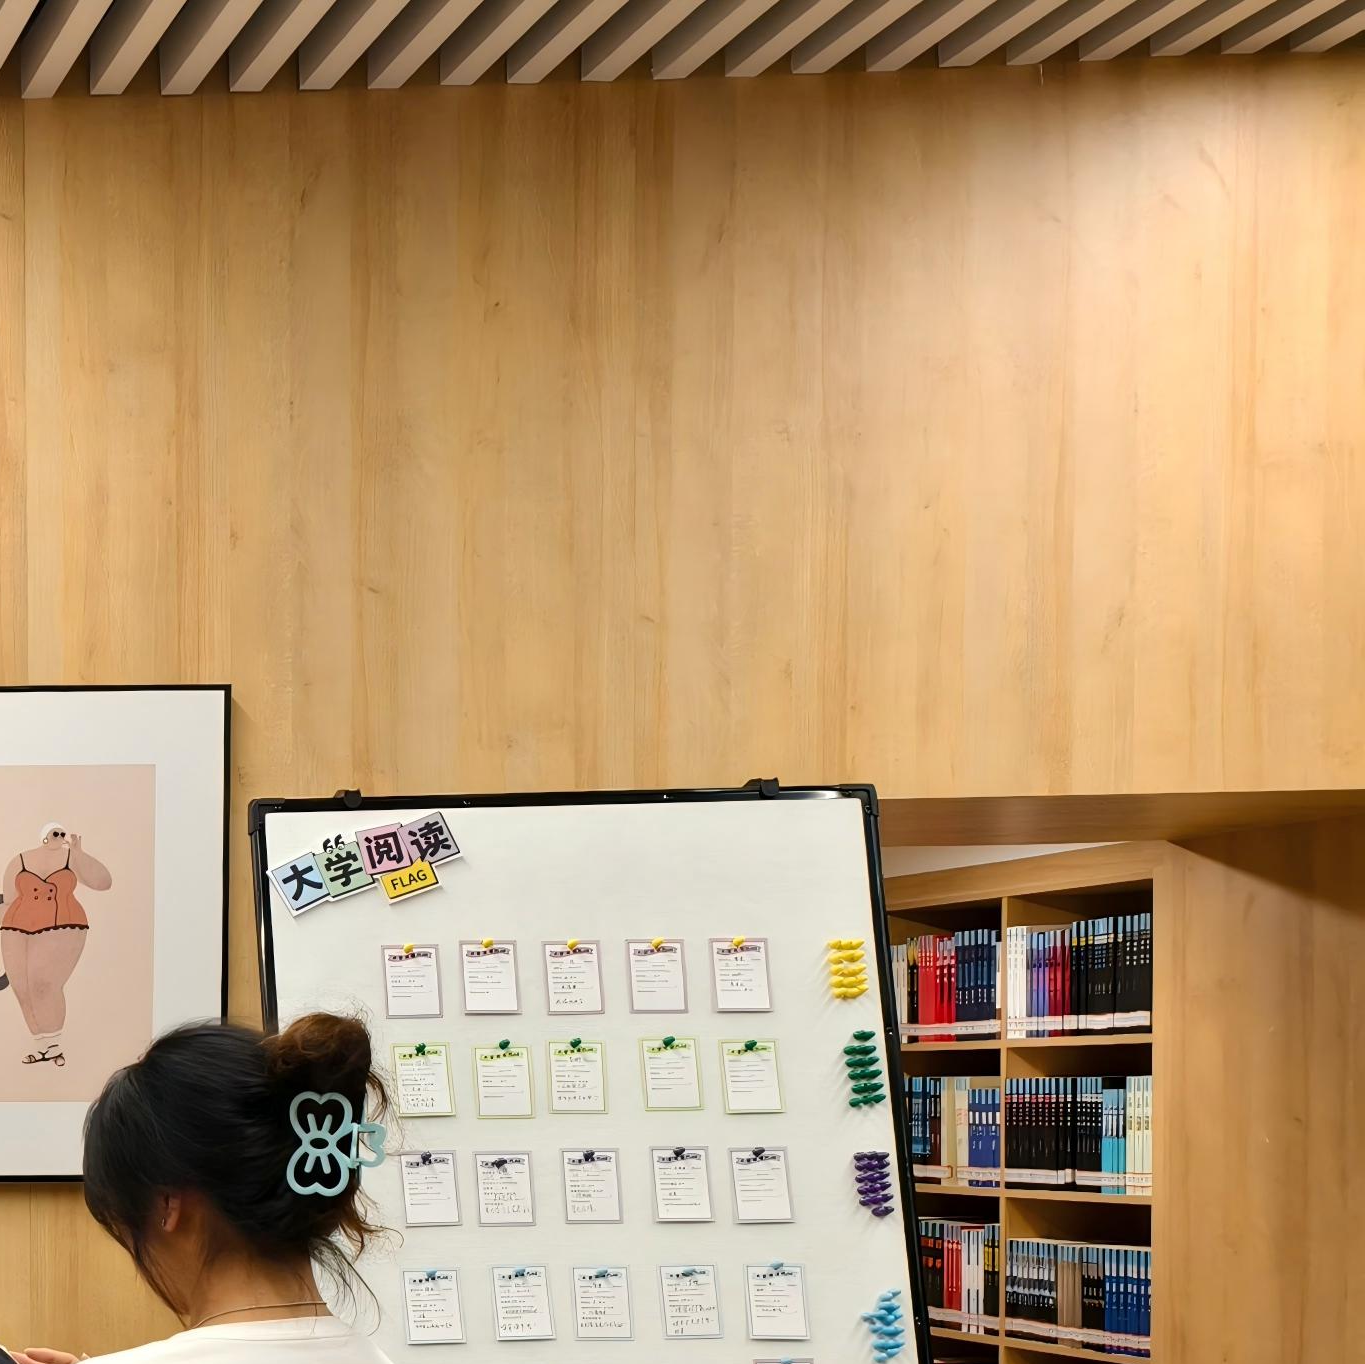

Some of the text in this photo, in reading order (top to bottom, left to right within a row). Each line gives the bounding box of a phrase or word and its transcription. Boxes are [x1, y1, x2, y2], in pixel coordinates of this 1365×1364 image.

[281, 820, 453, 902] 大学阅读
[390, 869, 428, 891] FLAG
